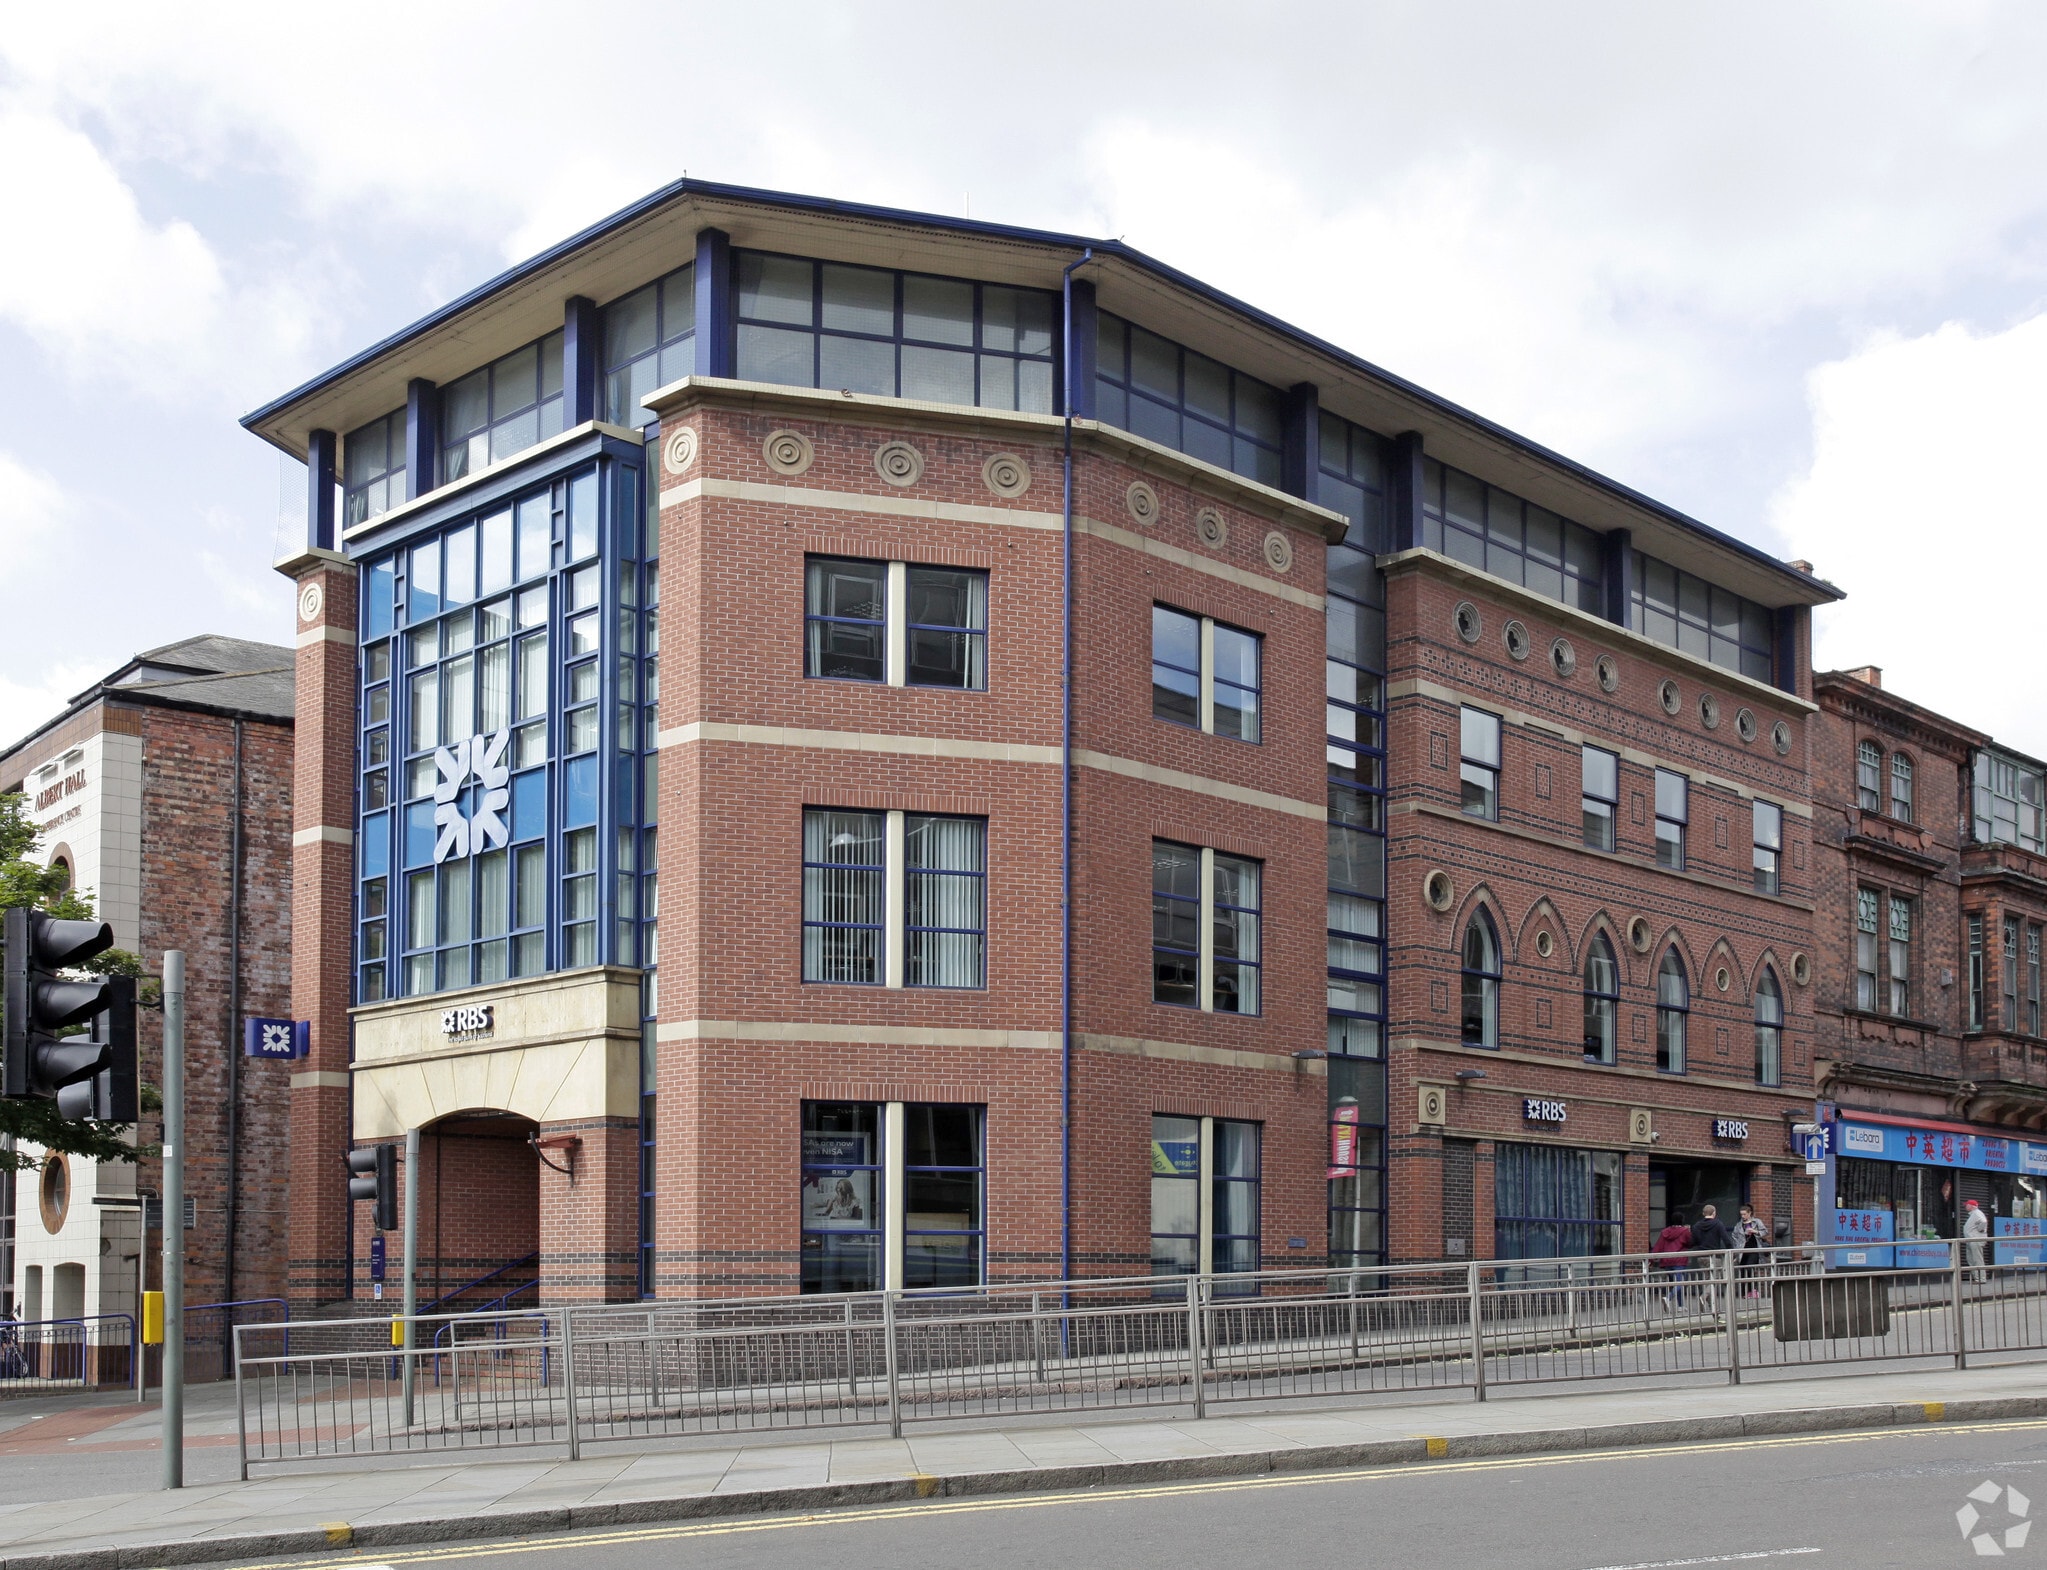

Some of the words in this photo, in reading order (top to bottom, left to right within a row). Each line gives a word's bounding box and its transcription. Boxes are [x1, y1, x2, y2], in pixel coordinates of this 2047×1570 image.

[35, 781, 64, 813] ALBERT
[65, 768, 87, 796] HALL
[457, 1005, 489, 1032] RBS
[1541, 1100, 1567, 1122] RBS
[1728, 1120, 1749, 1140] RBS
[1855, 1130, 1880, 1144] Lebara
[1906, 1130, 1971, 1165] 中英超市
[1838, 1211, 1882, 1232] 中英超市
